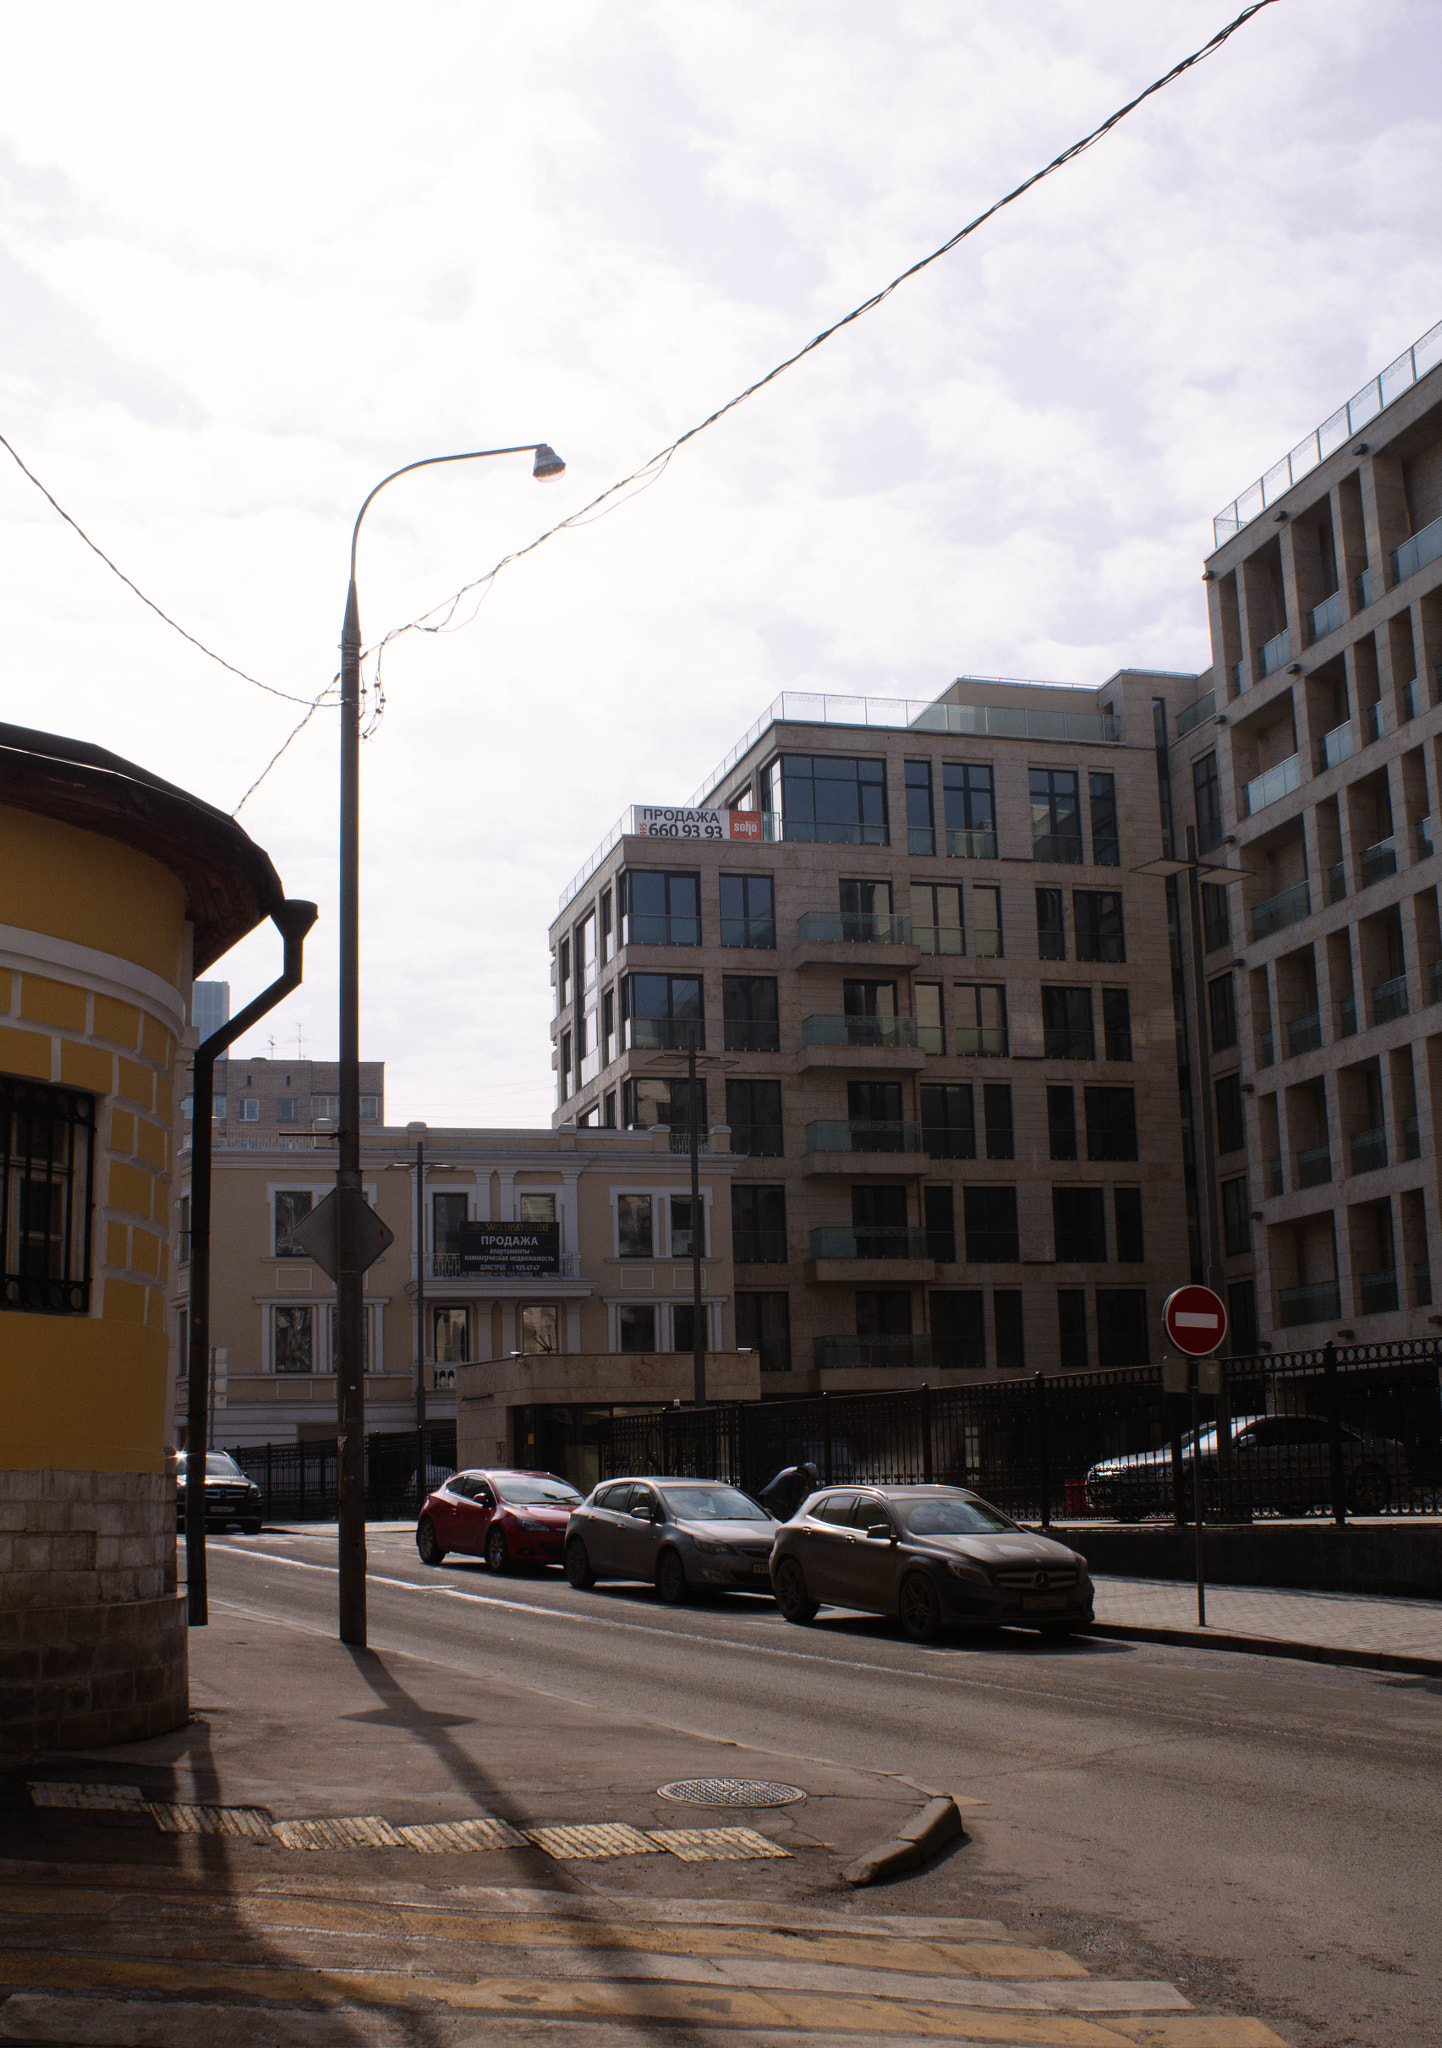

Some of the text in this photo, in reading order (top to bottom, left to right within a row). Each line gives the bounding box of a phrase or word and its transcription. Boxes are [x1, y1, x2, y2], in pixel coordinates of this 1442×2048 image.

[643, 808, 720, 824] ПРОДАЖА
[648, 822, 723, 839] 660 93 93
[480, 1235, 539, 1248] ПРОДАЖА
[489, 1248, 530, 1256] апартаменты
